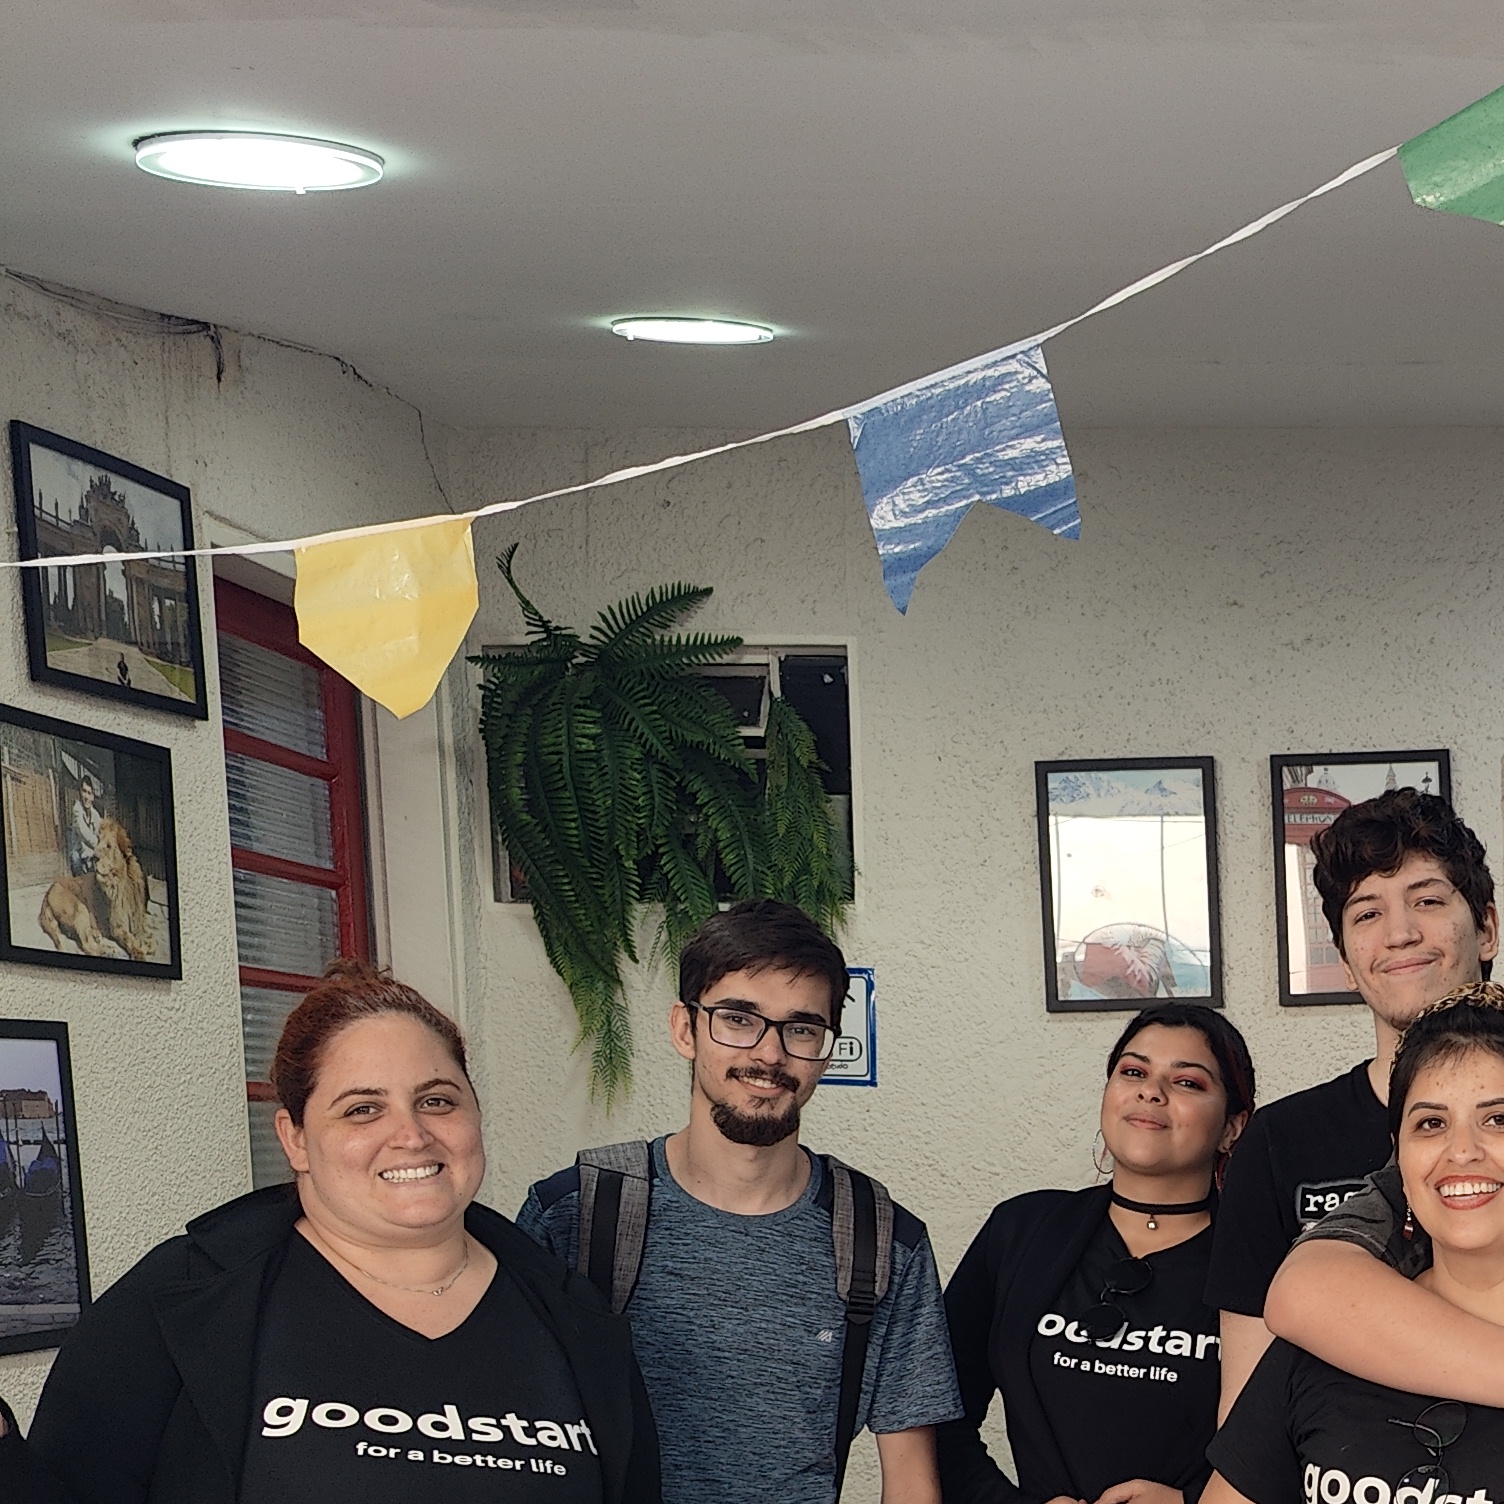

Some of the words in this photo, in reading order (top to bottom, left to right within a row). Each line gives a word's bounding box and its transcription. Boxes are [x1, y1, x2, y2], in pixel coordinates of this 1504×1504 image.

[1053, 1352, 1079, 1369] for
[1080, 1359, 1091, 1372] a
[1093, 1360, 1148, 1379] better
[1149, 1366, 1179, 1383] life
[261, 1396, 598, 1456] goodstart
[355, 1442, 402, 1459] for
[407, 1448, 425, 1462] a
[432, 1449, 526, 1471] better
[530, 1458, 568, 1476] life
